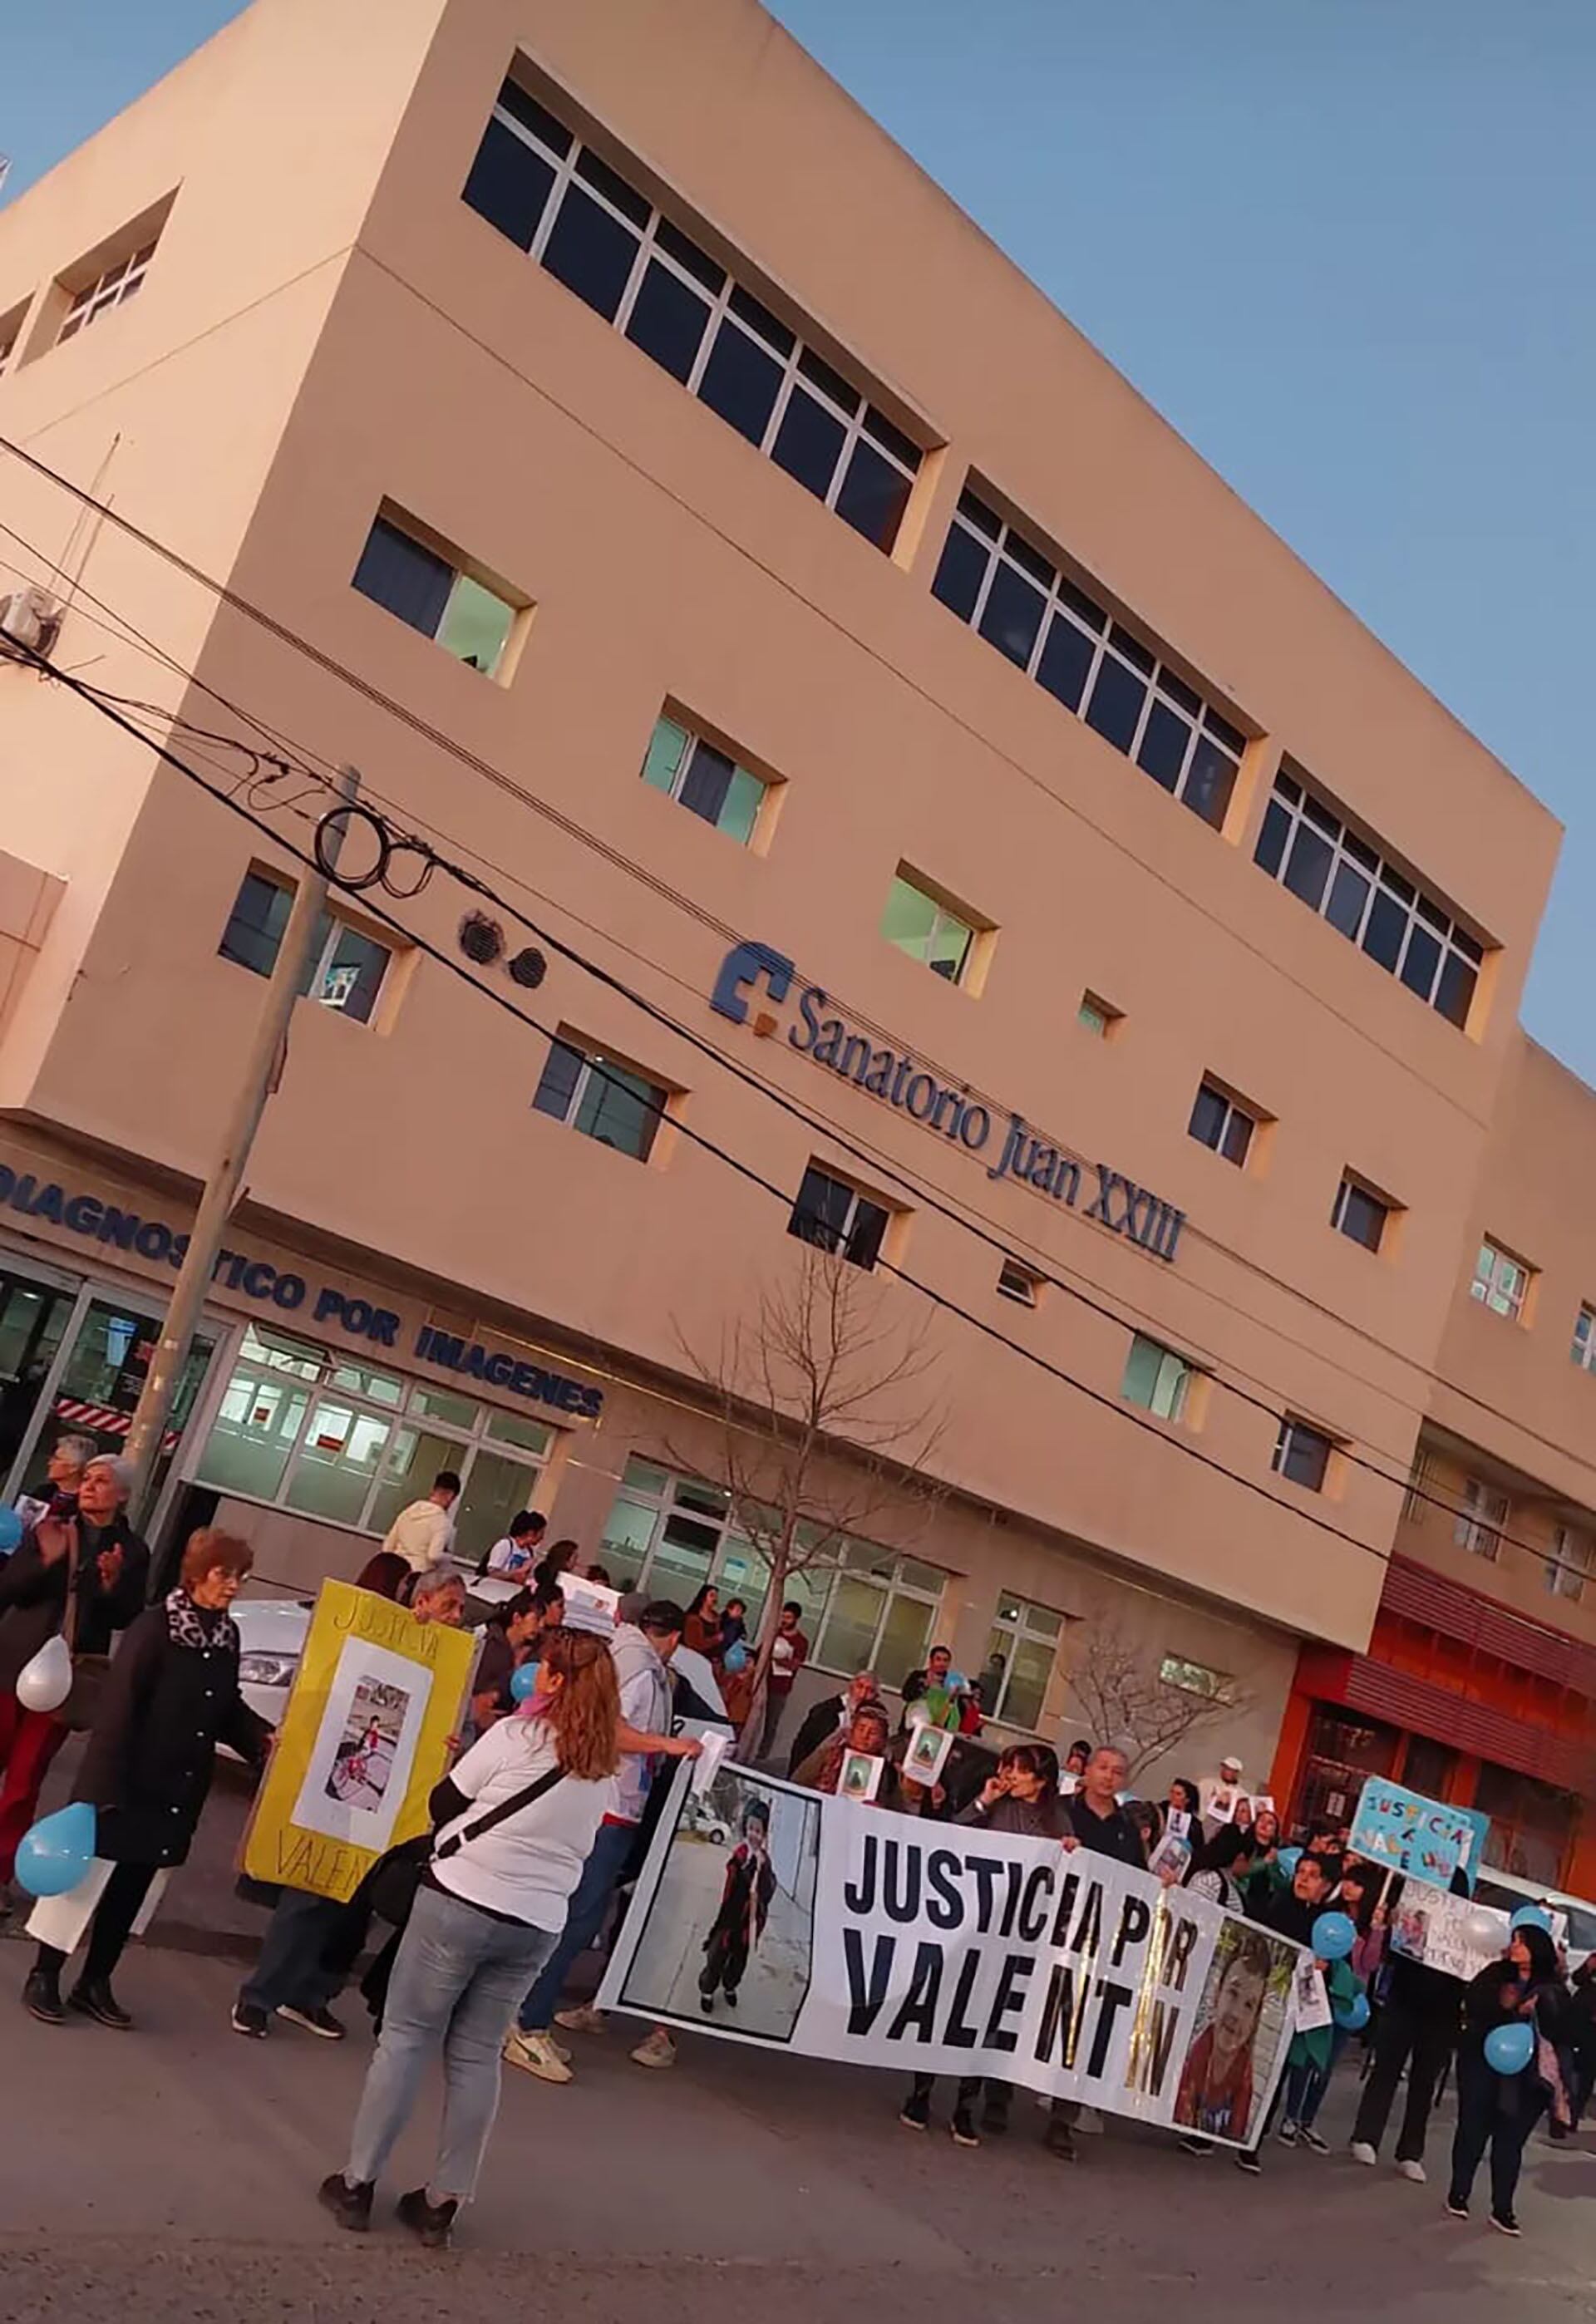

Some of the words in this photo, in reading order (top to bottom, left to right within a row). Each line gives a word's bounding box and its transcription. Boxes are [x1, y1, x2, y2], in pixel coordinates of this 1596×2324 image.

[788, 986, 991, 1150] Sanatorio
[987, 1113, 1082, 1207] Juan
[1082, 1163, 1187, 1263] XXIII
[314, 1288, 401, 1347] POR
[414, 1325, 603, 1418] IMAGENES
[843, 1834, 1103, 1958] JUSTICIA
